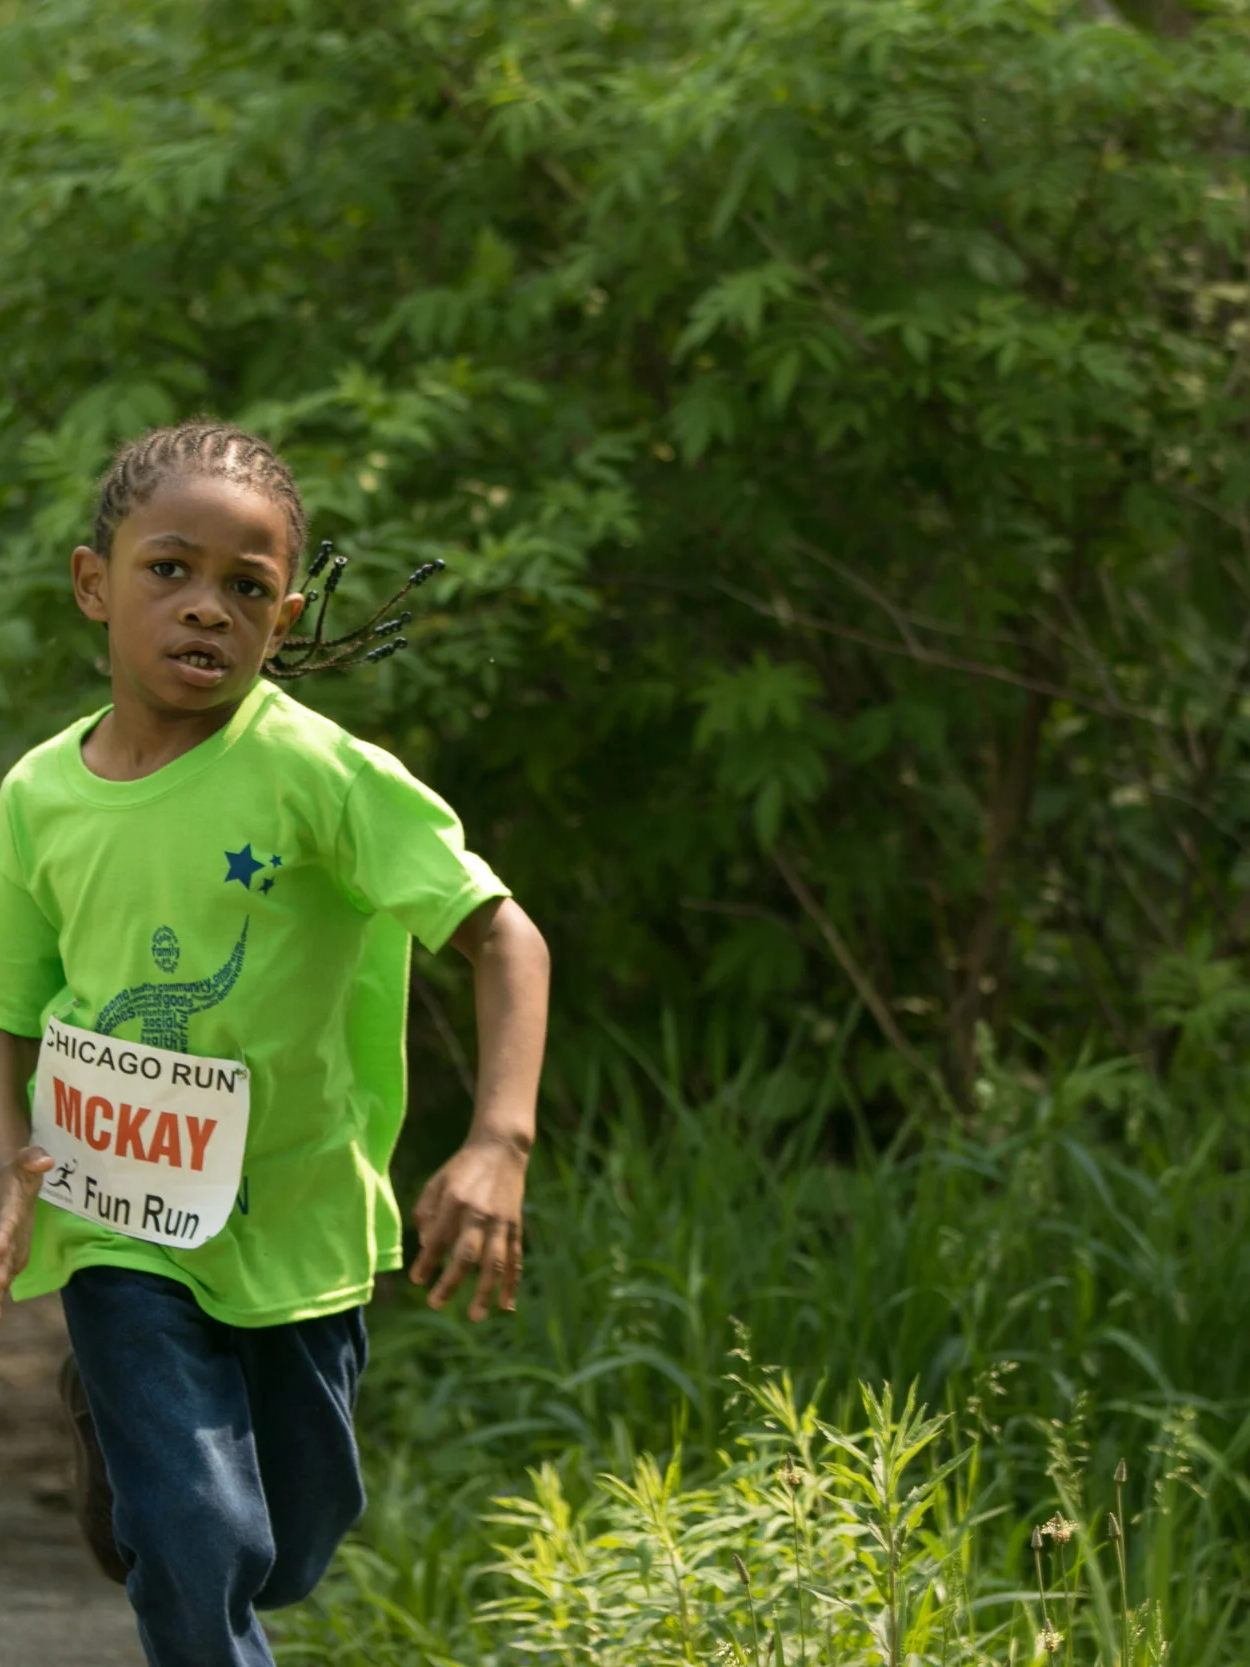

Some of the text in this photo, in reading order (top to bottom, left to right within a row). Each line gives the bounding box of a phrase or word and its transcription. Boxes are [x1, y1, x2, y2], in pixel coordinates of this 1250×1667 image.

[171, 1062, 236, 1094] RUN
[52, 1075, 218, 1172] MCKAY
[83, 1175, 131, 1225] Fun
[141, 1193, 201, 1240] Run
